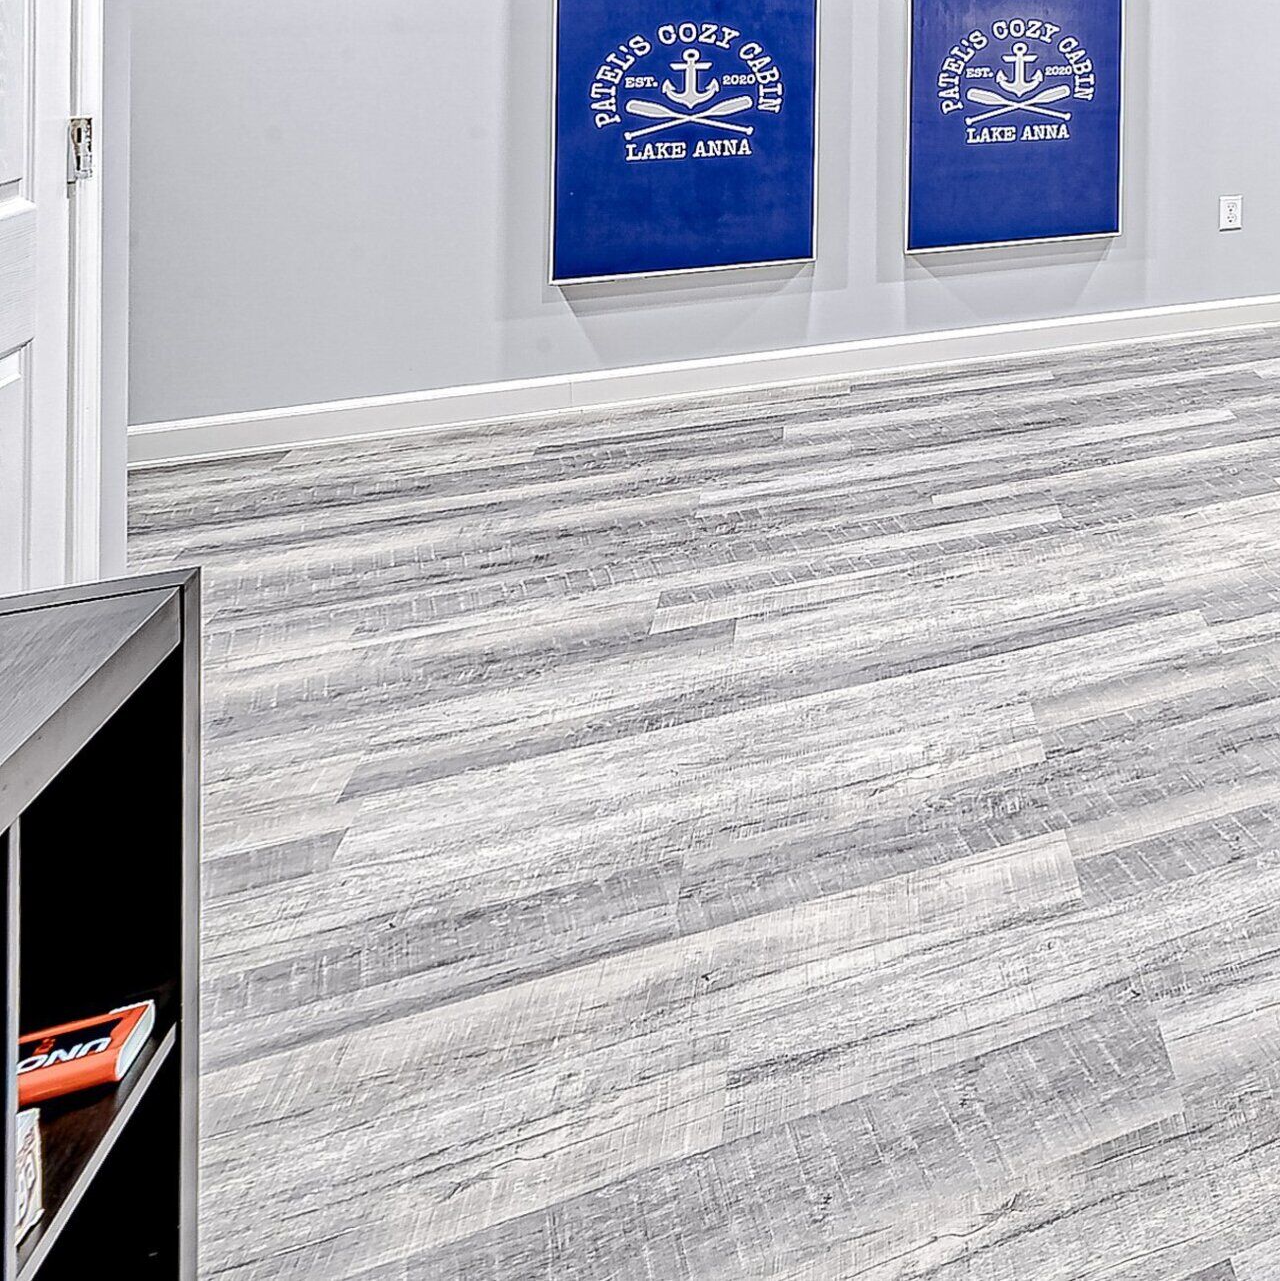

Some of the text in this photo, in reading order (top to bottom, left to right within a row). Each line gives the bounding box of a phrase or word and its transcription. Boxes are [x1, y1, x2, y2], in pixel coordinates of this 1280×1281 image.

[590, 22, 783, 128] PATEL'S COZY CABIN
[937, 18, 1095, 114] PATEL'S COZY CABIN
[965, 66, 1073, 78] EST. 2020
[624, 74, 756, 88] EST. 2020
[967, 124, 1070, 144] LAKE ANNA
[625, 138, 752, 161] LAKE ANNA
